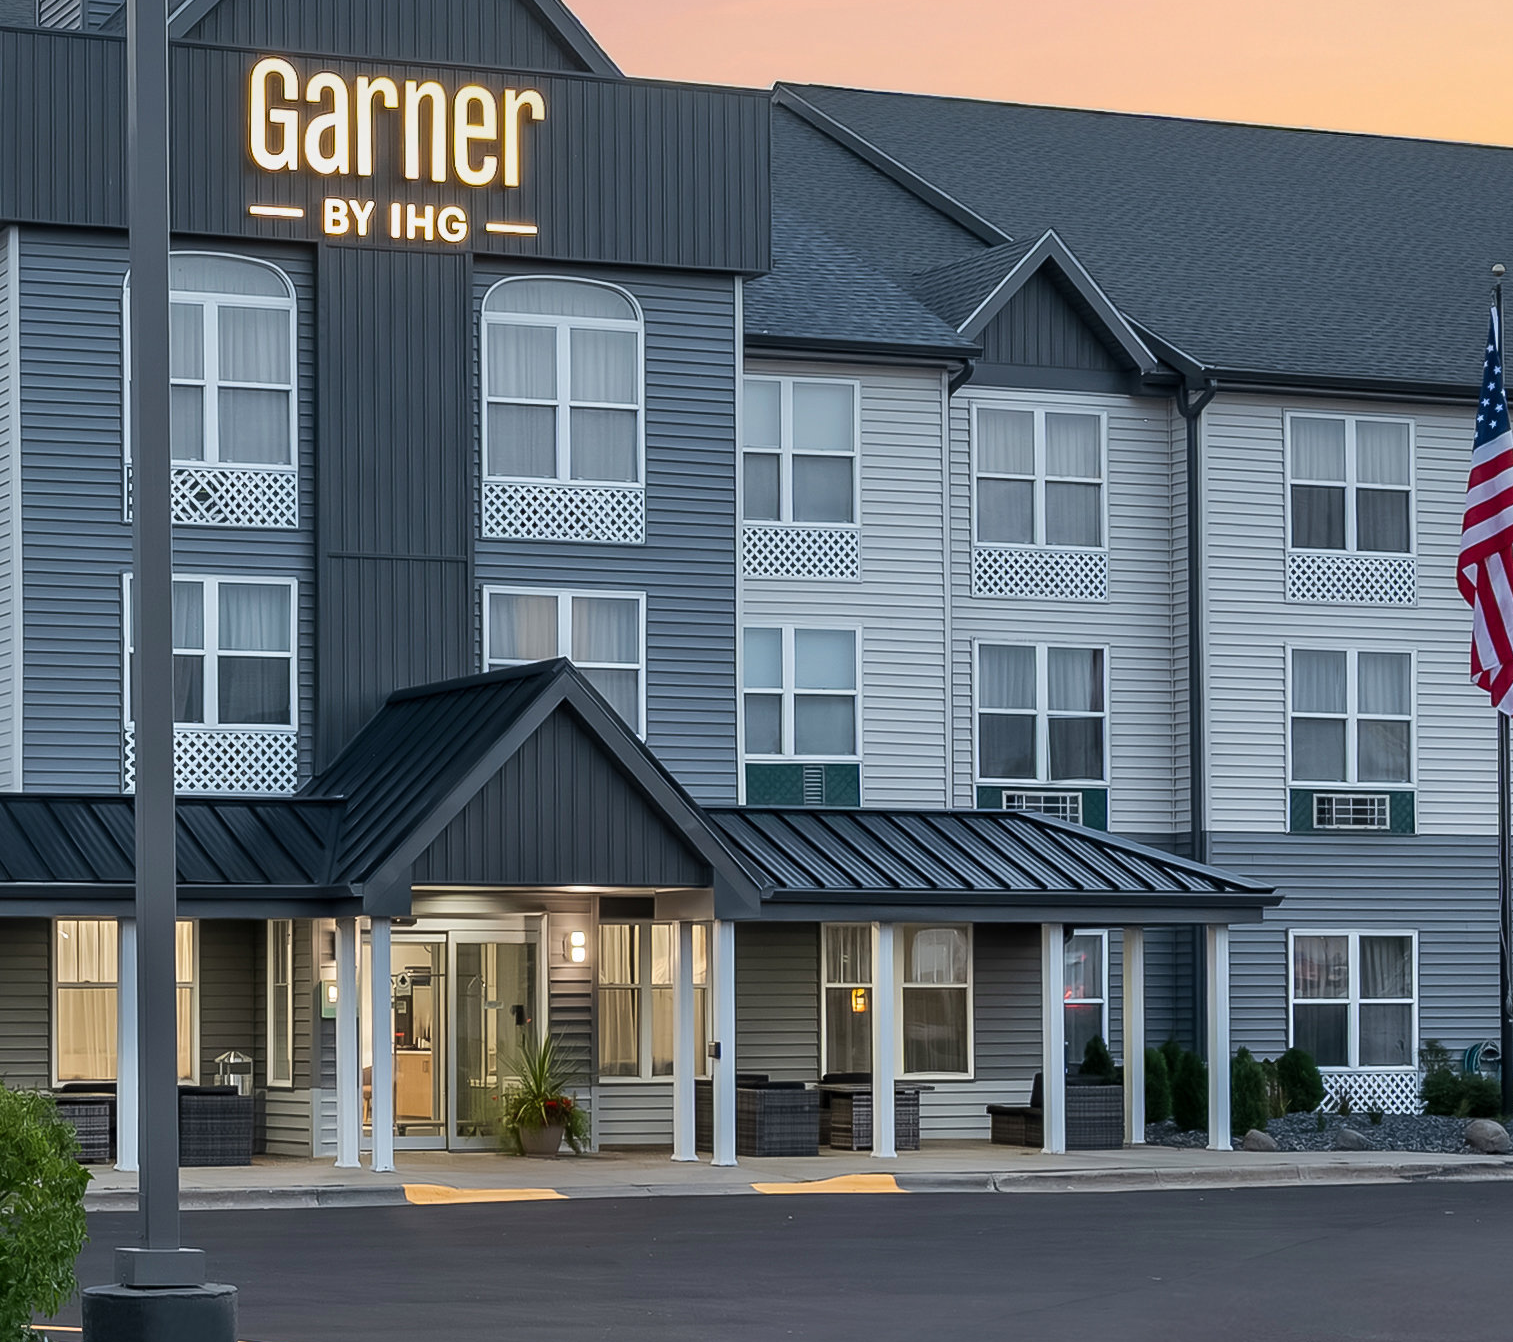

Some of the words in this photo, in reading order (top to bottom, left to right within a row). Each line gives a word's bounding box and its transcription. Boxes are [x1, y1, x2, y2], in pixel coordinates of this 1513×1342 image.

[249, 57, 546, 188] Garner
[322, 197, 376, 237] BY
[389, 201, 469, 244] IHG
